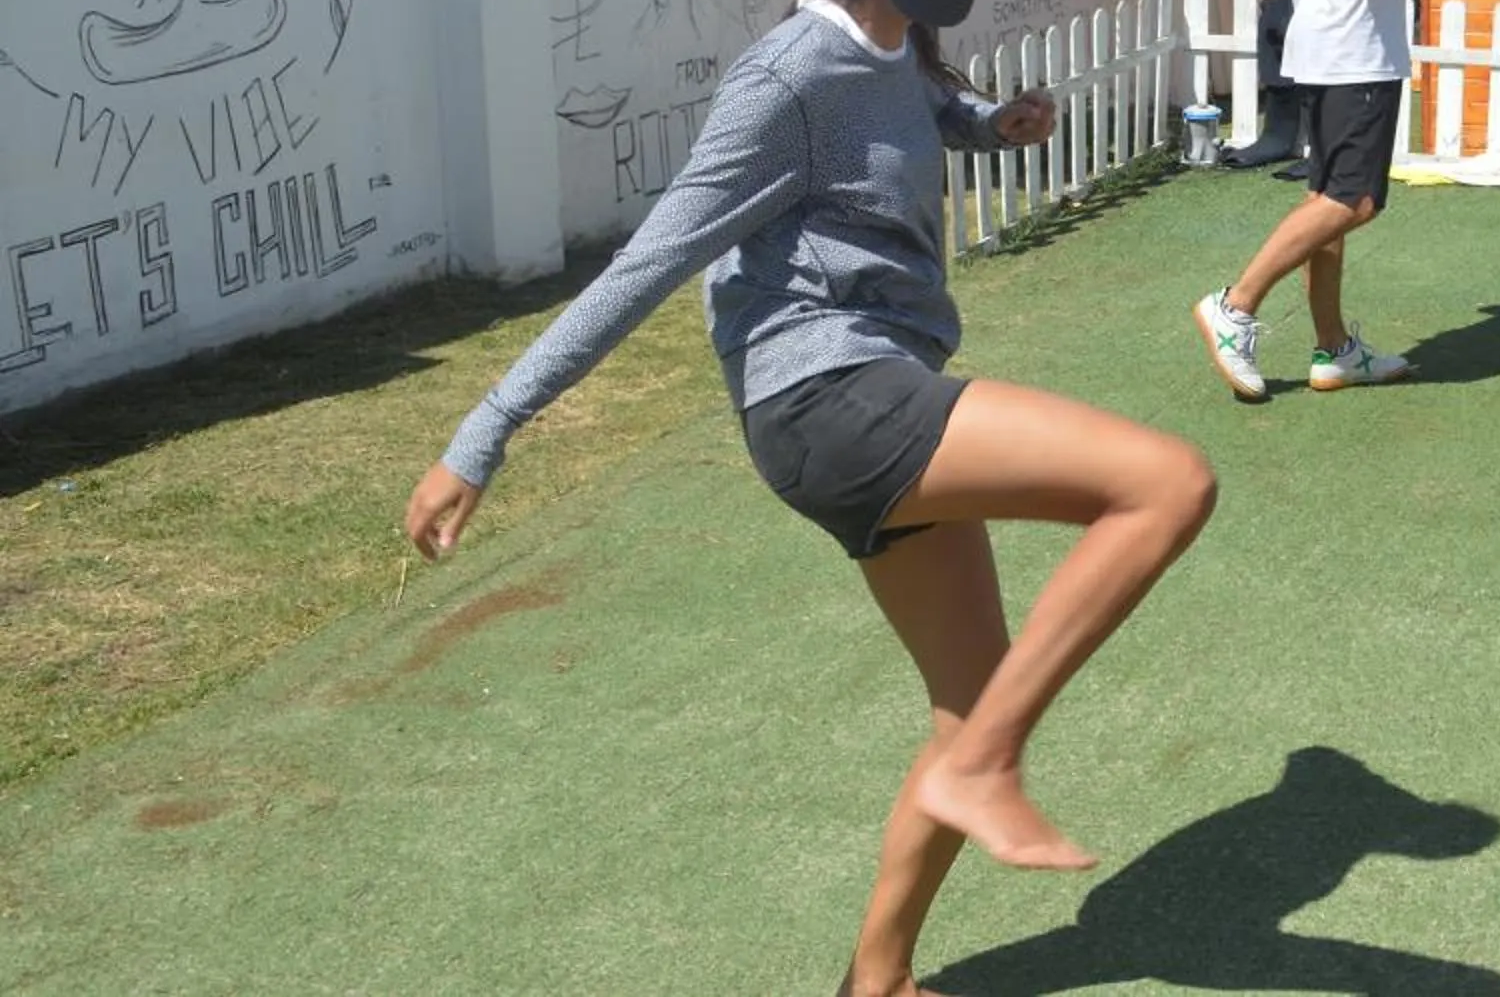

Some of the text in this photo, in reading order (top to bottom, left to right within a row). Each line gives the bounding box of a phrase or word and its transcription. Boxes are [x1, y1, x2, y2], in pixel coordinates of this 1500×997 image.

[54, 57, 320, 197] MY VIBE
[674, 52, 720, 90] FROM
[211, 162, 378, 298] CHILL
